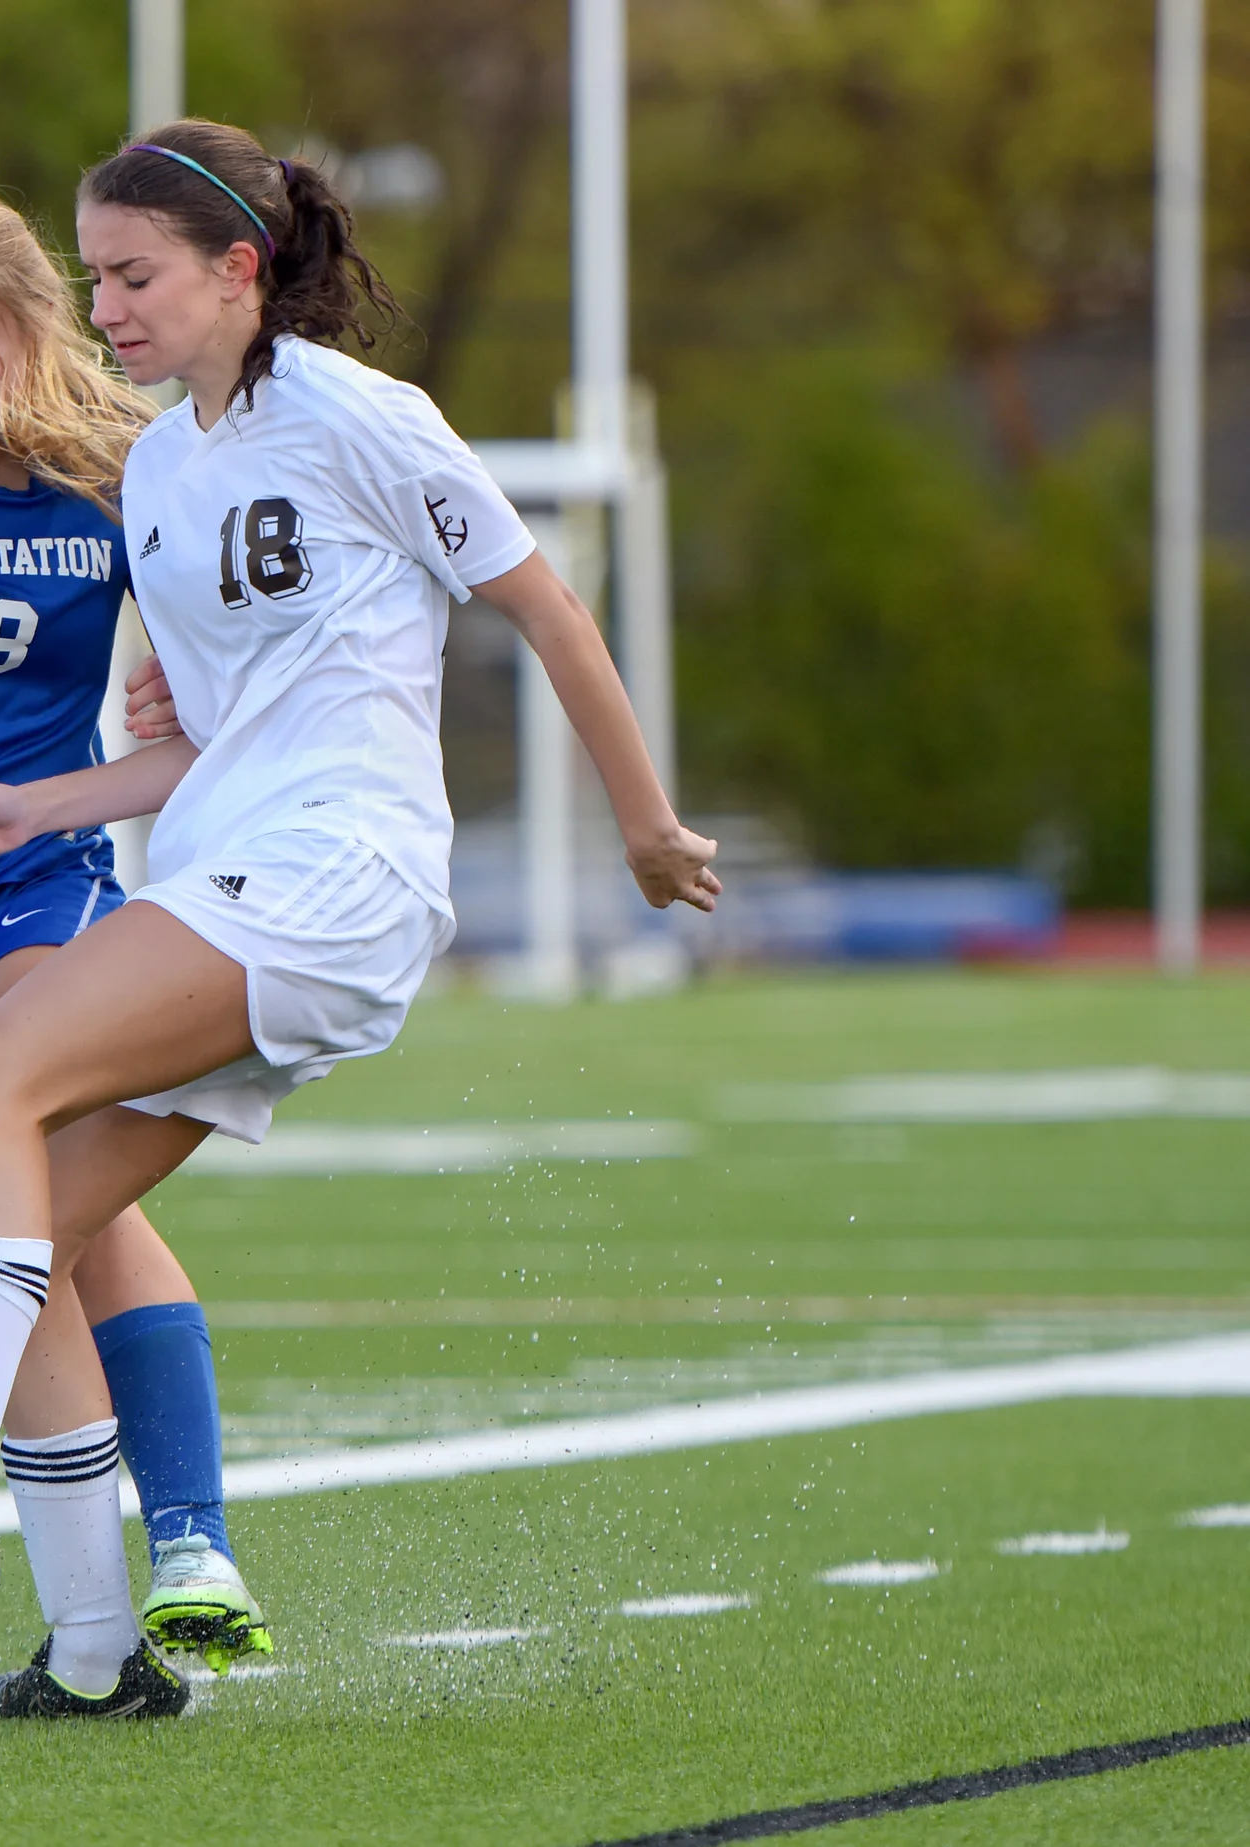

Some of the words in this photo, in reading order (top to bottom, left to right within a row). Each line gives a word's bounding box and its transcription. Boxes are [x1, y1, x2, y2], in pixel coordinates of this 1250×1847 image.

[140, 542, 162, 560] adidas
[219, 498, 313, 610] 18
[208, 874, 241, 901] adidas
